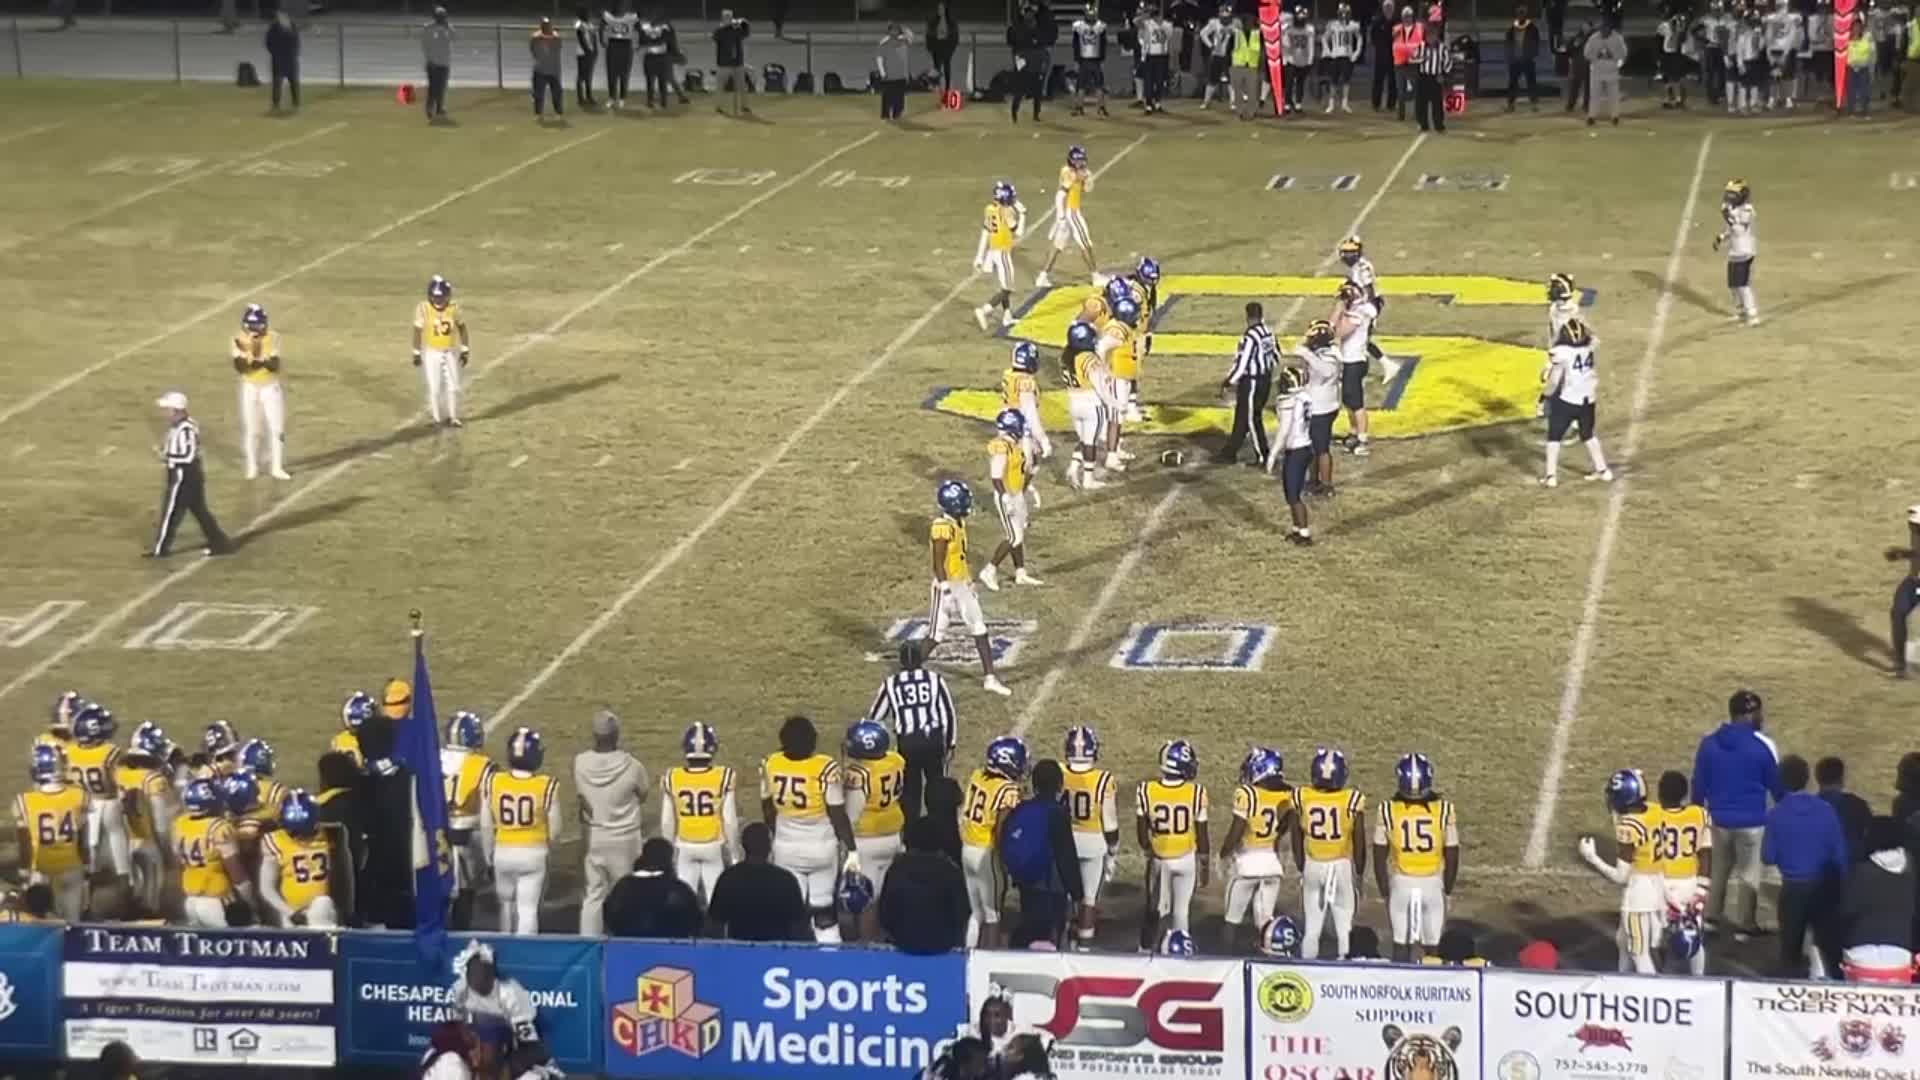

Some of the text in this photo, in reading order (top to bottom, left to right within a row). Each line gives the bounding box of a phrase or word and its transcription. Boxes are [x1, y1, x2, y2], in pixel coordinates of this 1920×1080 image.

[1571, 352, 1595, 372] 44
[898, 682, 931, 704] 136
[678, 789, 715, 817] 36
[773, 775, 808, 810] 75
[499, 794, 535, 827] 60
[1154, 804, 1190, 835] 20
[1309, 807, 1342, 841] 21
[37, 809, 75, 845] 64
[1400, 819, 1434, 853] 15
[1663, 826, 1698, 860] 33
[292, 853, 329, 884] 53
[84, 929, 310, 959] TEAM TROTMAN
[360, 982, 578, 1008] CHESAPEA ONAL
[763, 967, 929, 1021] Sports
[1320, 983, 1472, 1002] SOUTH NORFOLK RURITANS
[1751, 997, 1838, 1014] TIGER
[1777, 987, 1905, 1007] Welcome
[96, 1003, 131, 1016] Tiger
[200, 1006, 221, 1020] for
[224, 1008, 254, 1019] over
[278, 1009, 321, 1022] years!
[1355, 1008, 1436, 1024] SUPPORT
[1514, 989, 1693, 1026] SOUTHSIDE
[612, 1015, 721, 1058] CHKD
[1262, 1034, 1332, 1056] THE
[1158, 1054, 1223, 1066] GROUP
[1264, 1063, 1377, 1080] OSCAR
[1746, 1062, 1772, 1075] The
[1775, 1062, 1815, 1076] South
[1819, 1064, 1872, 1079] Norfolk
